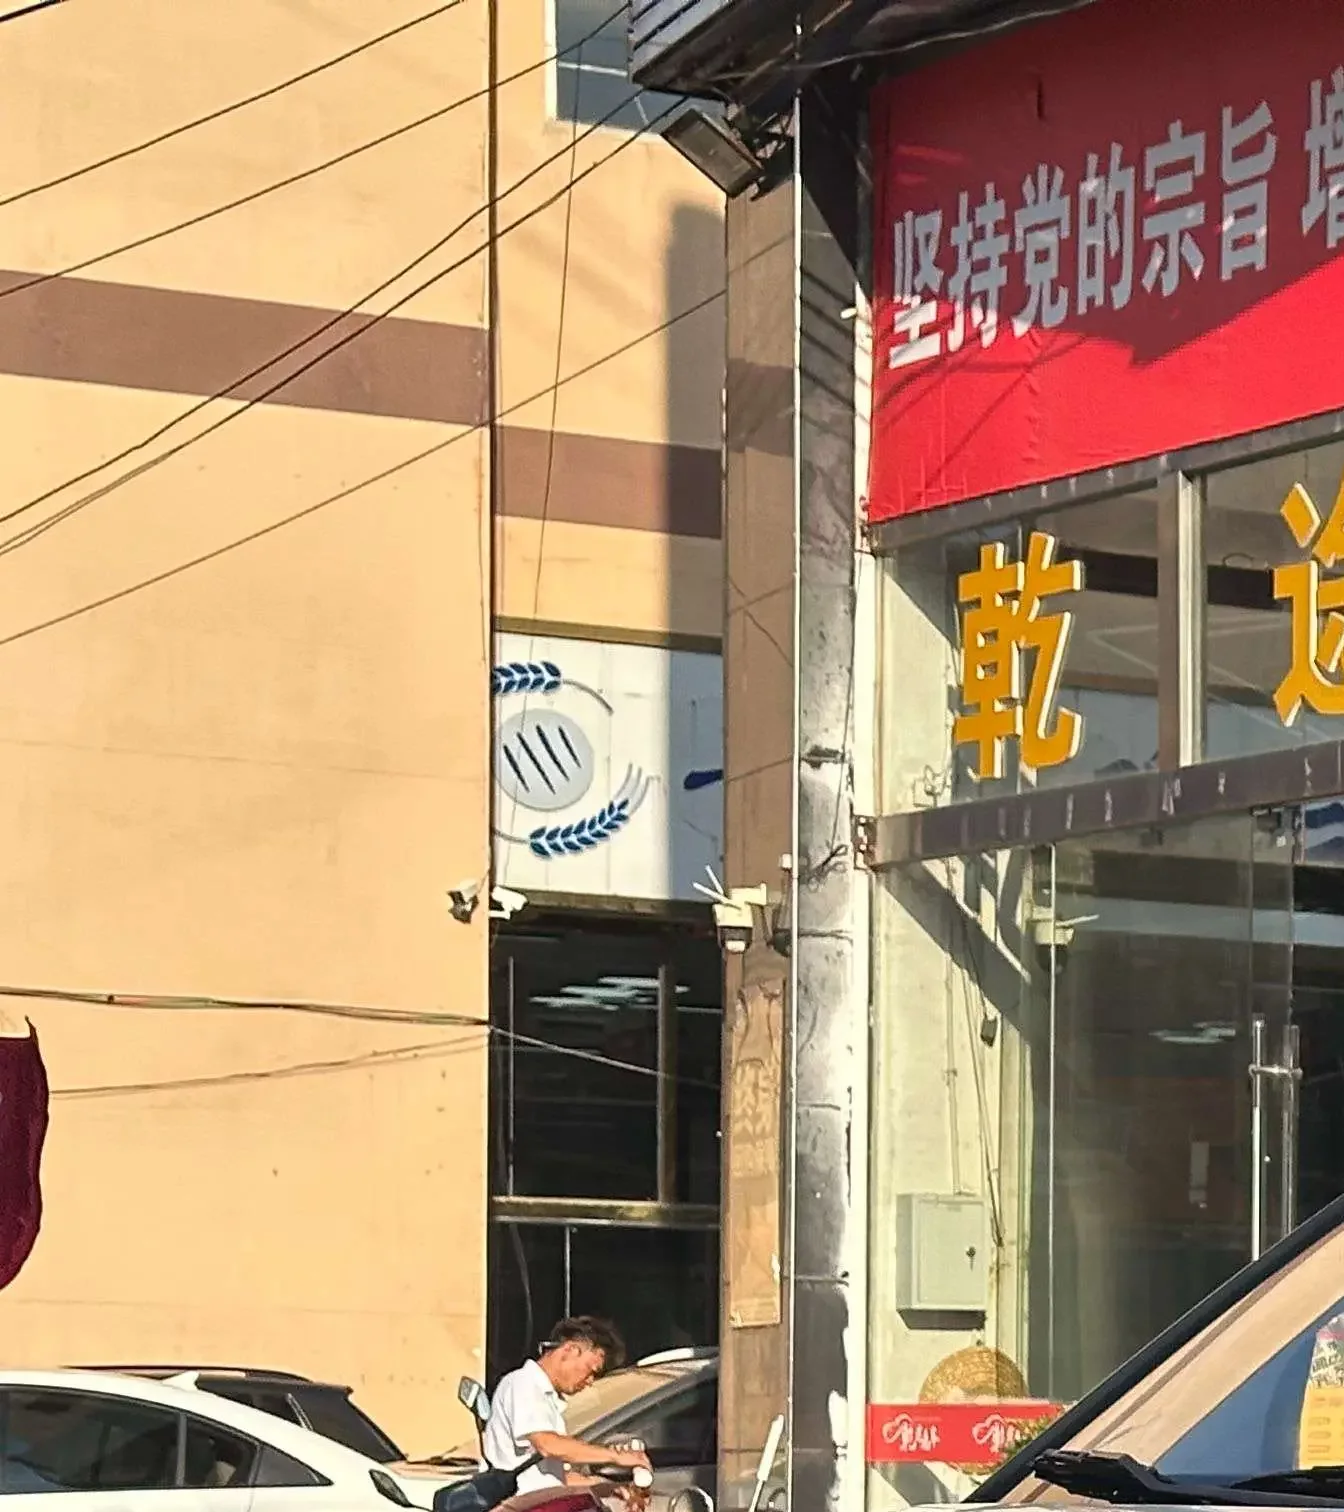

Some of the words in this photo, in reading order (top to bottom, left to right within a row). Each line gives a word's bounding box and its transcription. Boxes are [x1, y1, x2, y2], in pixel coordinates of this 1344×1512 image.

[889, 100, 1277, 369] 坚持党的宗旨
